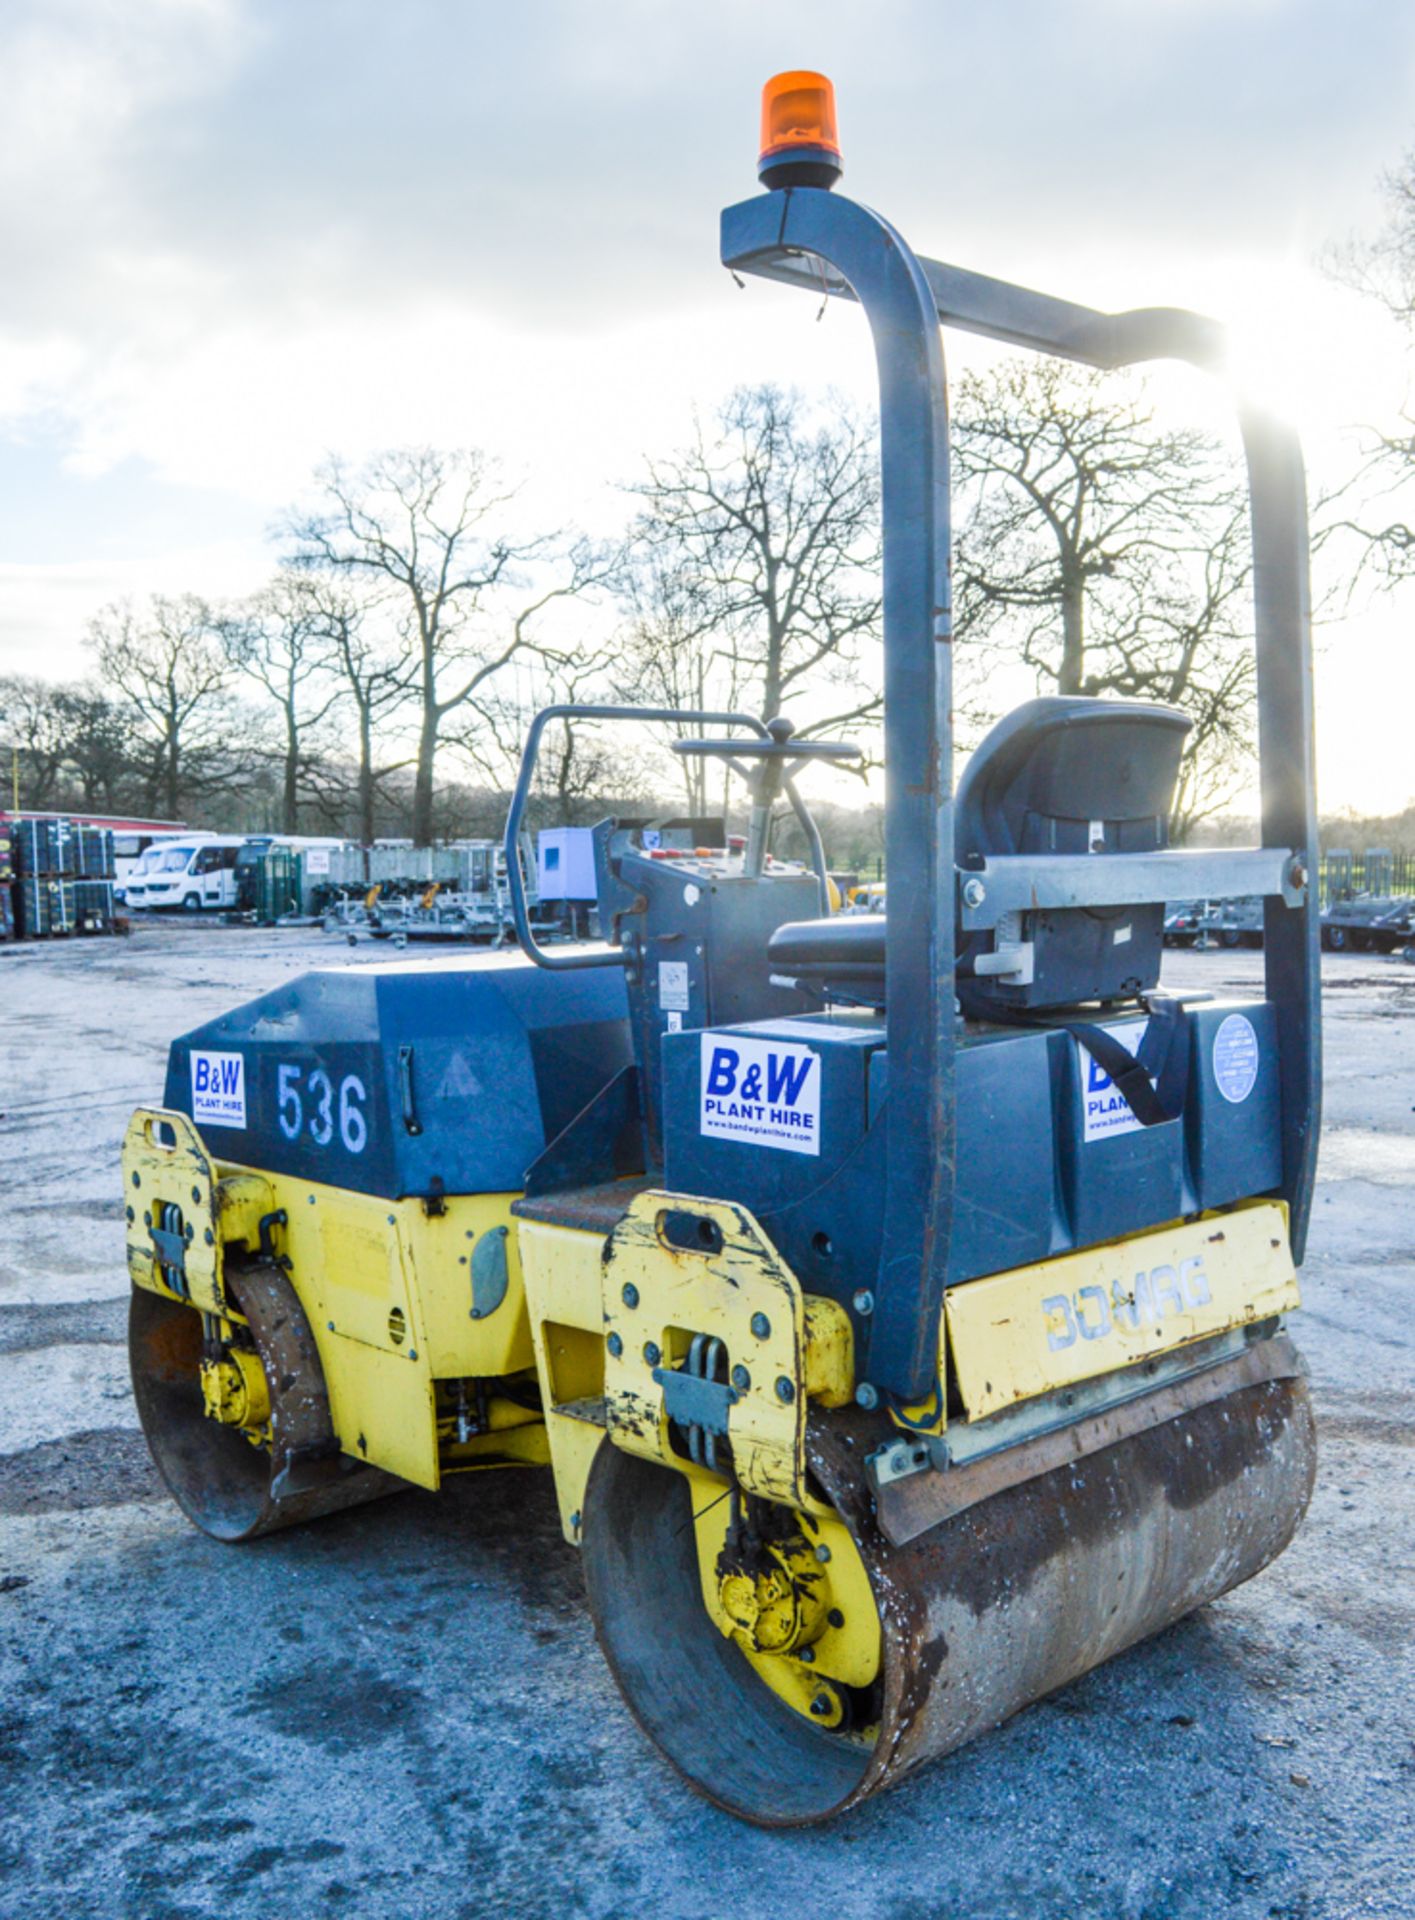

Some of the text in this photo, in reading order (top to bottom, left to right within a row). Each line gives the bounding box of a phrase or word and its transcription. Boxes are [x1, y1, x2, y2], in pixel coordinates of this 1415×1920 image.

[195, 1057, 241, 1096] B&W
[707, 1047, 814, 1106] B&W
[195, 1097, 221, 1109] PLANT
[278, 1064, 367, 1153] 536
[705, 1099, 814, 1129] PLANT HIRE
[1088, 1095, 1129, 1116] PLAN
